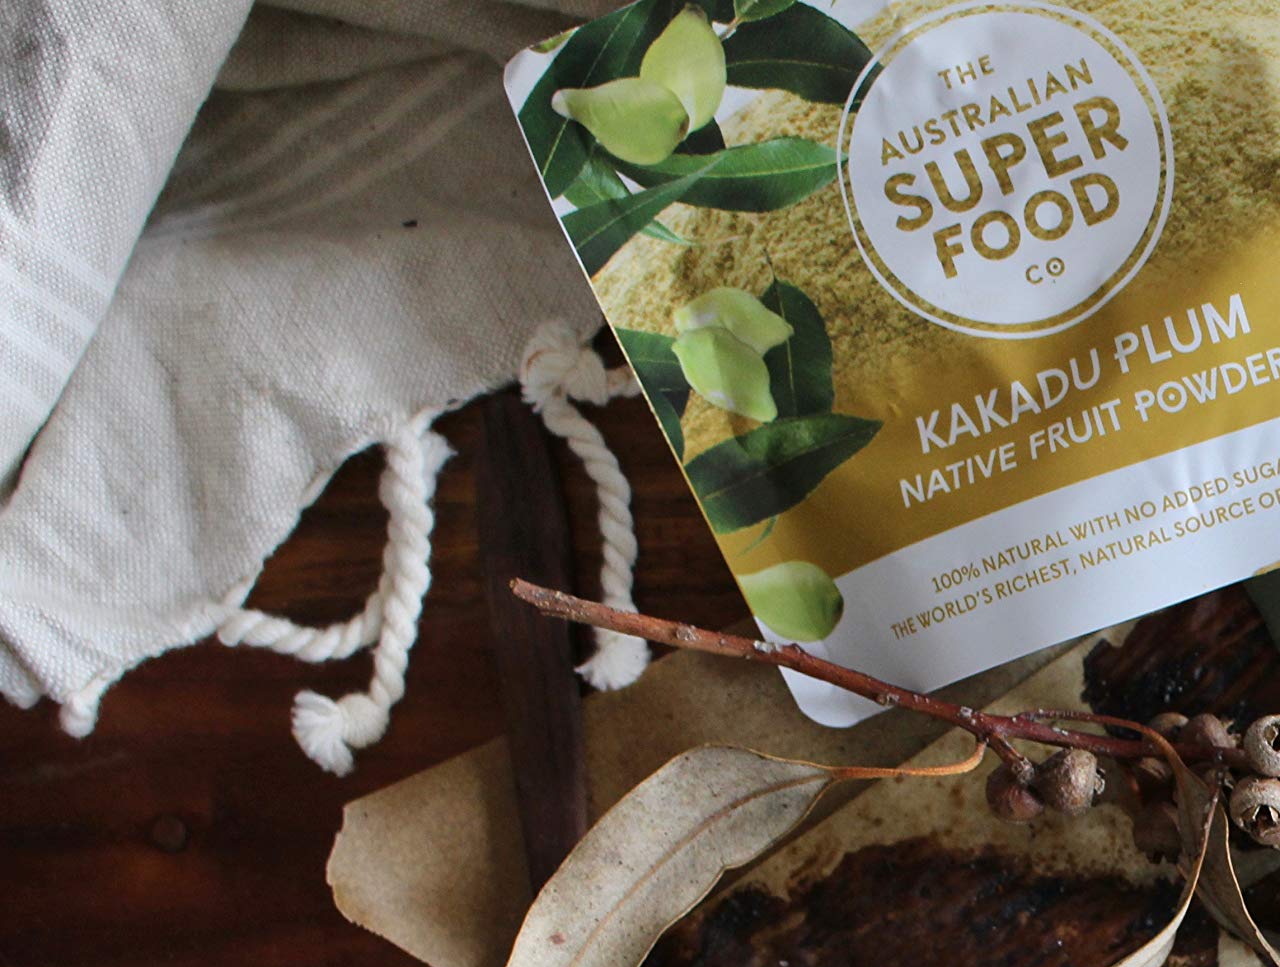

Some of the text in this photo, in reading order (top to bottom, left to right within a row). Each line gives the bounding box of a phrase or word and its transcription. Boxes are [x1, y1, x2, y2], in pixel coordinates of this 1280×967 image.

[880, 57, 1094, 166] AUSTRALIAN
[937, 54, 994, 90] THE
[884, 95, 1129, 232] SUPER
[932, 172, 1120, 279] FOOD
[1025, 257, 1066, 285] CO
[916, 293, 1252, 454] KAKADU PLUM
[899, 442, 1017, 509] NATIVE
[1029, 398, 1122, 460] FRUIT
[890, 617, 918, 640] THE
[916, 588, 993, 629] WORLD'S
[994, 558, 1078, 600] RICHEST,
[1079, 527, 1172, 569] NATURAL
[1174, 498, 1255, 538] SOURCE
[932, 562, 981, 594] 100%
[982, 531, 1069, 574] NATURAL
[1069, 512, 1121, 541] WITH
[1124, 501, 1157, 525] NO
[1162, 477, 1229, 513] ADDED
